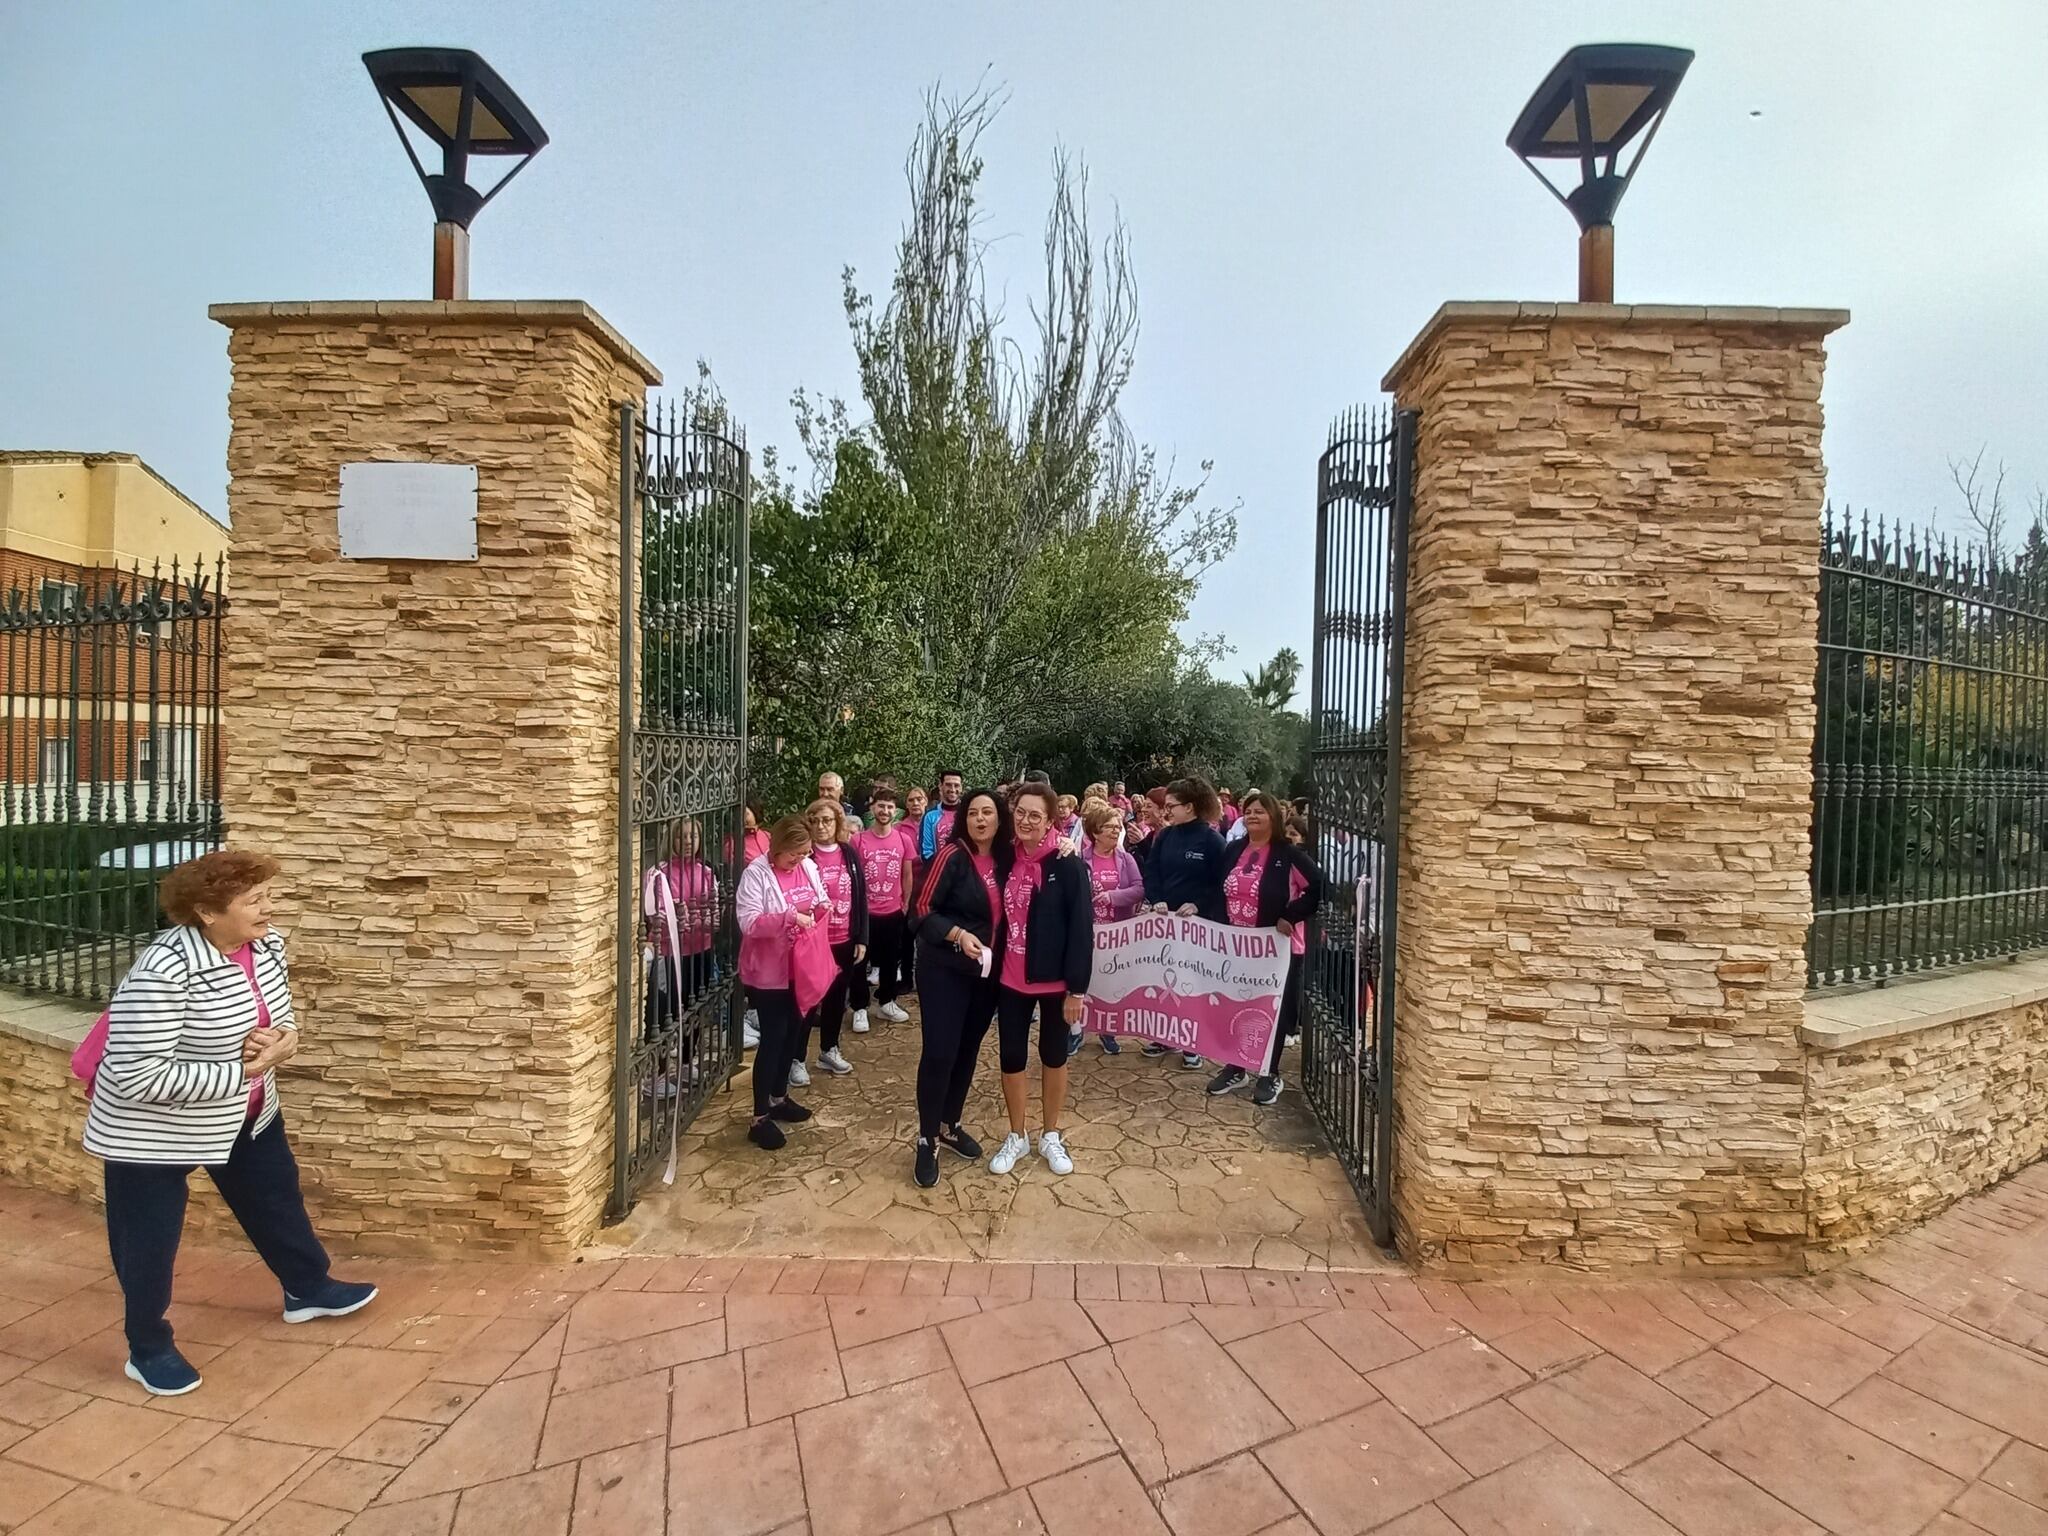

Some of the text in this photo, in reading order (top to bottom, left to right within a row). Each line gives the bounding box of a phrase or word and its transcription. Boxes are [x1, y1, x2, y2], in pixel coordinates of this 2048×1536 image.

[1093, 926, 1129, 951] CHA
[1134, 919, 1176, 946] ROSA
[1181, 920, 1206, 949] POR
[1210, 928, 1227, 955] LA
[1232, 933, 1278, 958] VIDA
[1135, 943, 1176, 966] unido
[1177, 960, 1215, 978] contra
[1215, 960, 1231, 983] el
[1232, 972, 1282, 988] cáncer
[1094, 1008, 1118, 1033] TE
[1123, 1008, 1199, 1048] RINDAS!
